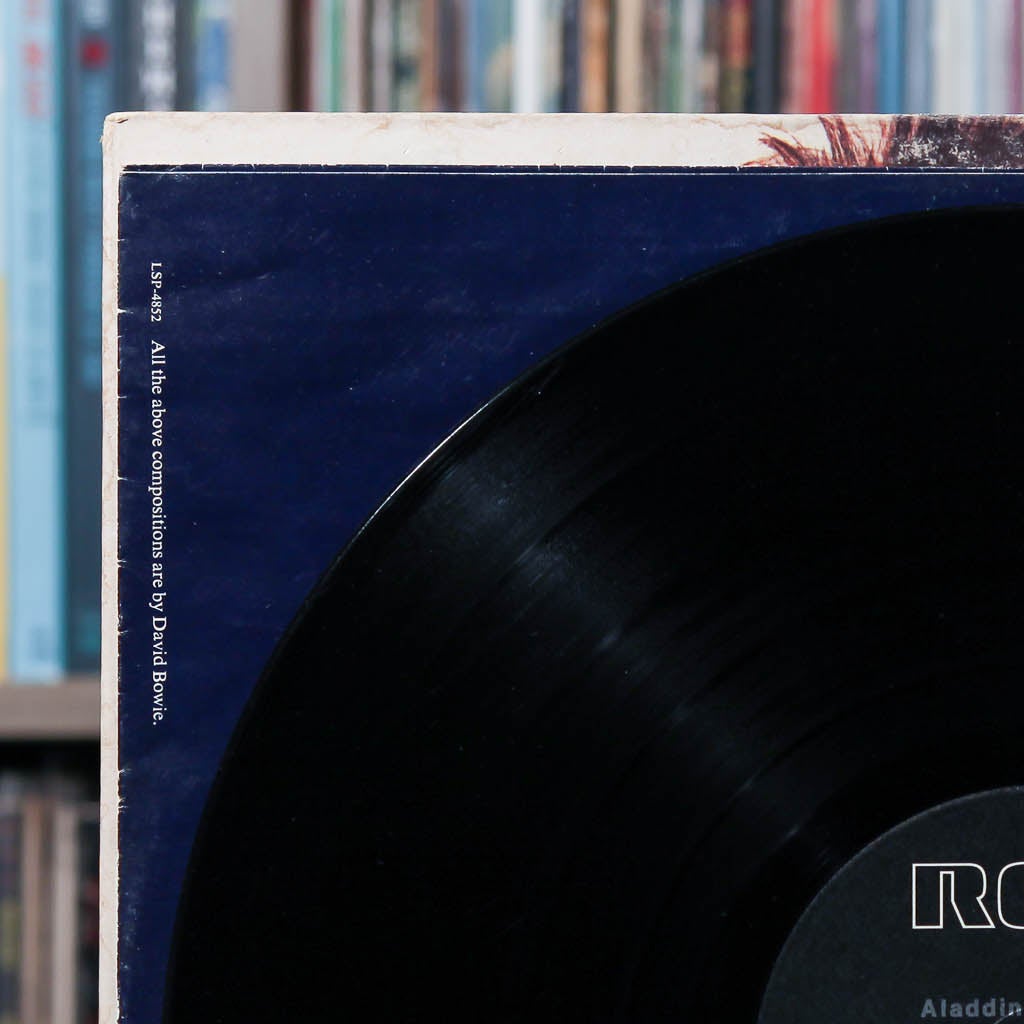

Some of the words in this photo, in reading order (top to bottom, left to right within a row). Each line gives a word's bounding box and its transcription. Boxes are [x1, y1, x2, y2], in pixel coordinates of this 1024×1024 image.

[151, 263, 162, 322] LSP-4852
[152, 340, 165, 365] All
[152, 369, 166, 394] the
[152, 400, 166, 446] above
[148, 451, 166, 558] compositions
[152, 563, 162, 587] are
[149, 592, 166, 611] by
[153, 616, 167, 666] David
[153, 671, 167, 725] Bowie.
[921, 998, 1022, 1019] Aladdin
